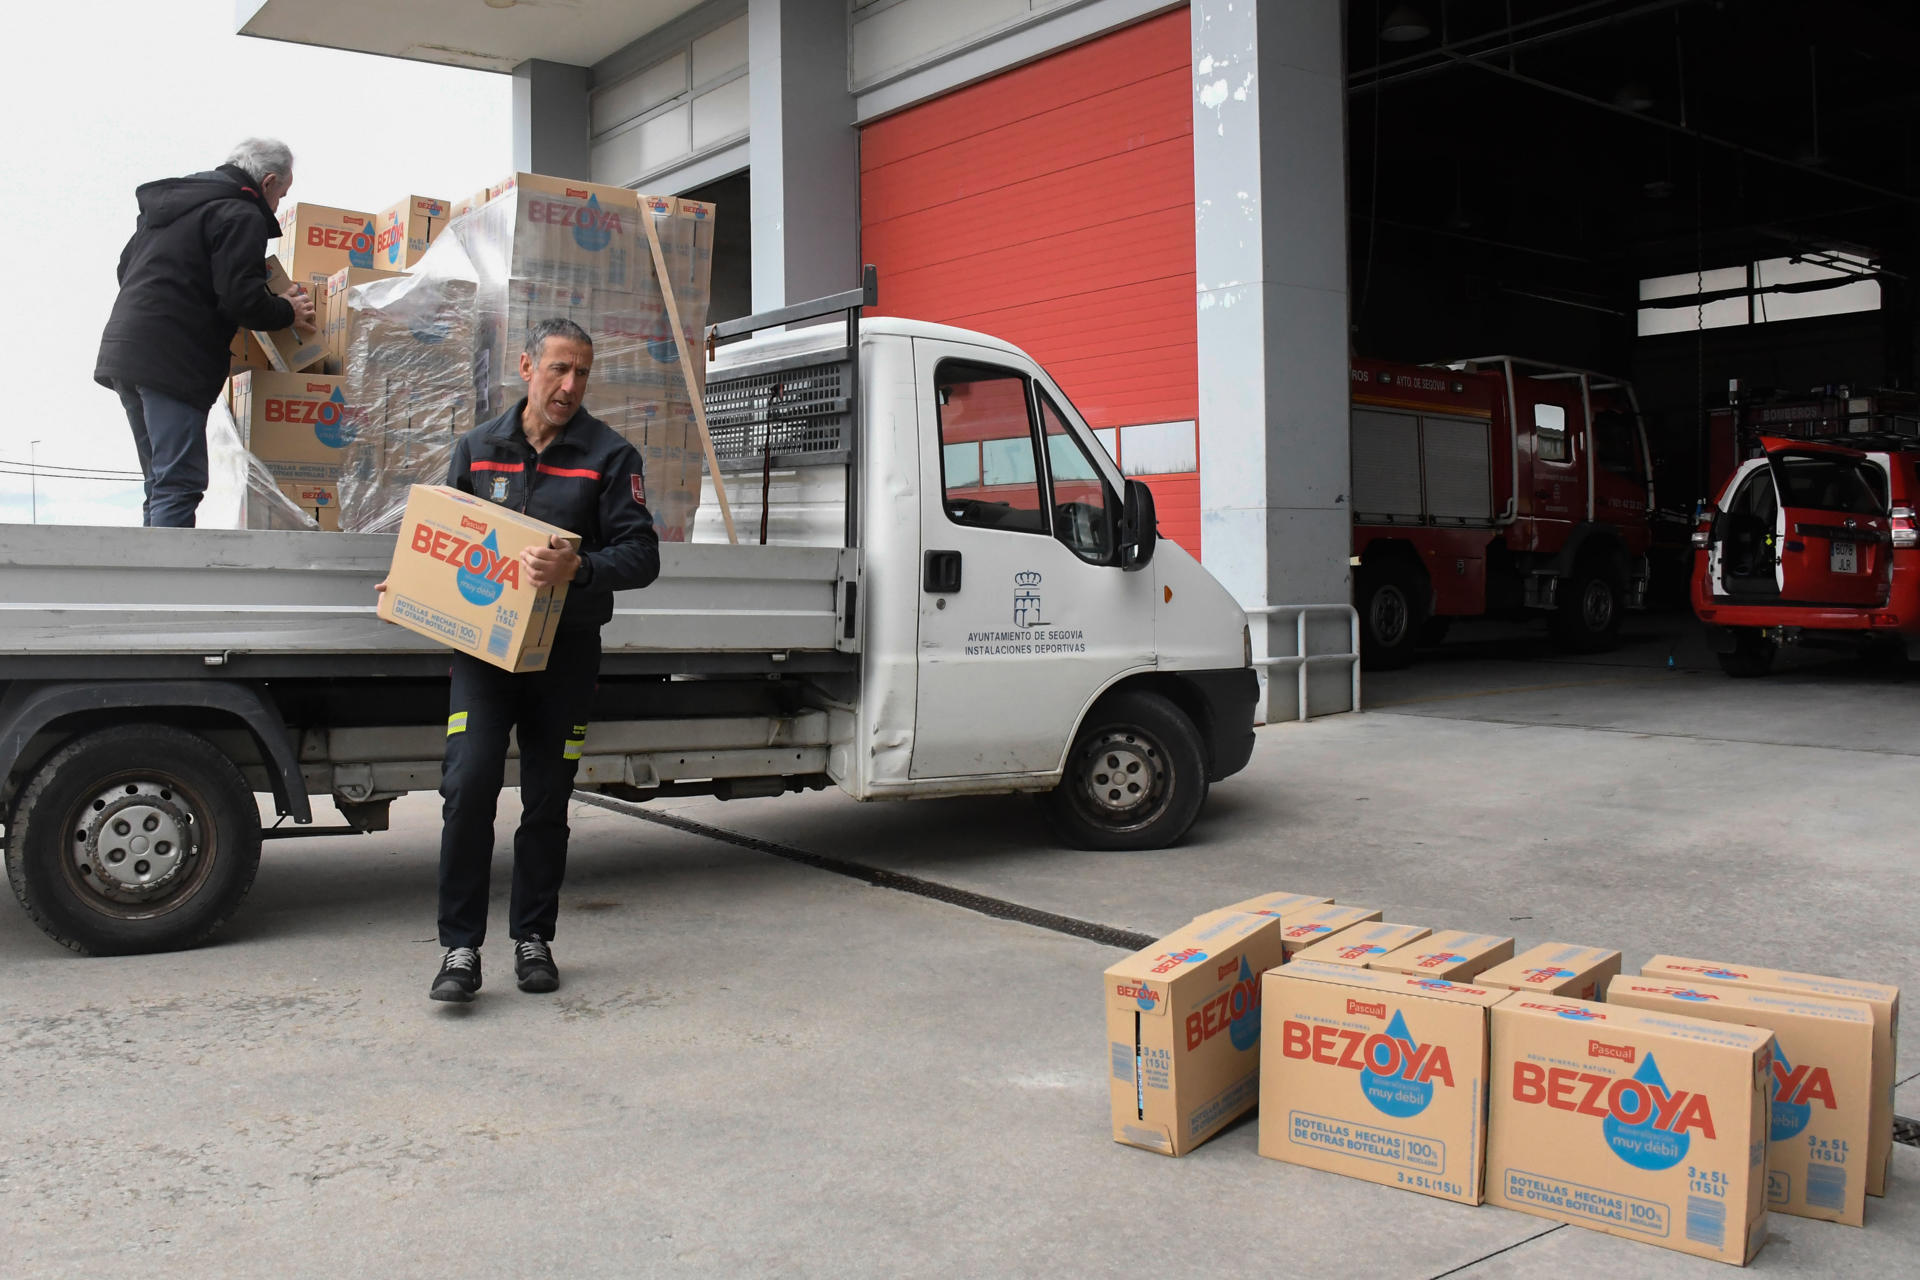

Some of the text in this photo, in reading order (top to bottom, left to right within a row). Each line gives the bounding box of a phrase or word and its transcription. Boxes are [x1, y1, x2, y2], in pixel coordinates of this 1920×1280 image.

[528, 200, 623, 234] BEZOYA
[1422, 378, 1446, 391] SEGOVIA
[1762, 406, 1817, 421] BOMBEROS
[411, 523, 520, 590] BEZOYA
[397, 600, 457, 629] BOTELLAS HECHAS
[405, 610, 425, 623] OTRAS
[425, 619, 455, 636] BOTELLAS
[968, 630, 1083, 642] AYUNTAMIENTO DE SEGOVIA
[965, 643, 1085, 656] INSTALACIONES DEPORTIVAS
[1151, 948, 1204, 974] BEZOYA
[1117, 985, 1161, 1002] BEZOYA
[1186, 970, 1261, 1052] BEZOY
[1349, 1001, 1385, 1016] Pascual
[1144, 1046, 1150, 1056] 3
[1283, 1020, 1455, 1088] BEZOYA
[1591, 1042, 1633, 1060] Pascual
[1146, 1058, 1169, 1070] (15L)
[1369, 1087, 1394, 1103] muy
[1513, 1061, 1717, 1140] BEZOYA
[1295, 1117, 1400, 1148] BOTELLAS HECHAS
[1808, 1135, 1816, 1146] 3
[1294, 1128, 1400, 1159] DE OTRAS BOTELLAS
[1612, 1136, 1642, 1153] muy
[1810, 1148, 1846, 1164] (15L)
[1397, 1172, 1404, 1183] 3
[1688, 1166, 1696, 1178] 3
[1510, 1176, 1622, 1210] BOTELLAS HECHAS
[1689, 1180, 1725, 1198] (15L)
[1510, 1185, 1622, 1221] DE OTRAS BOTELLAS
